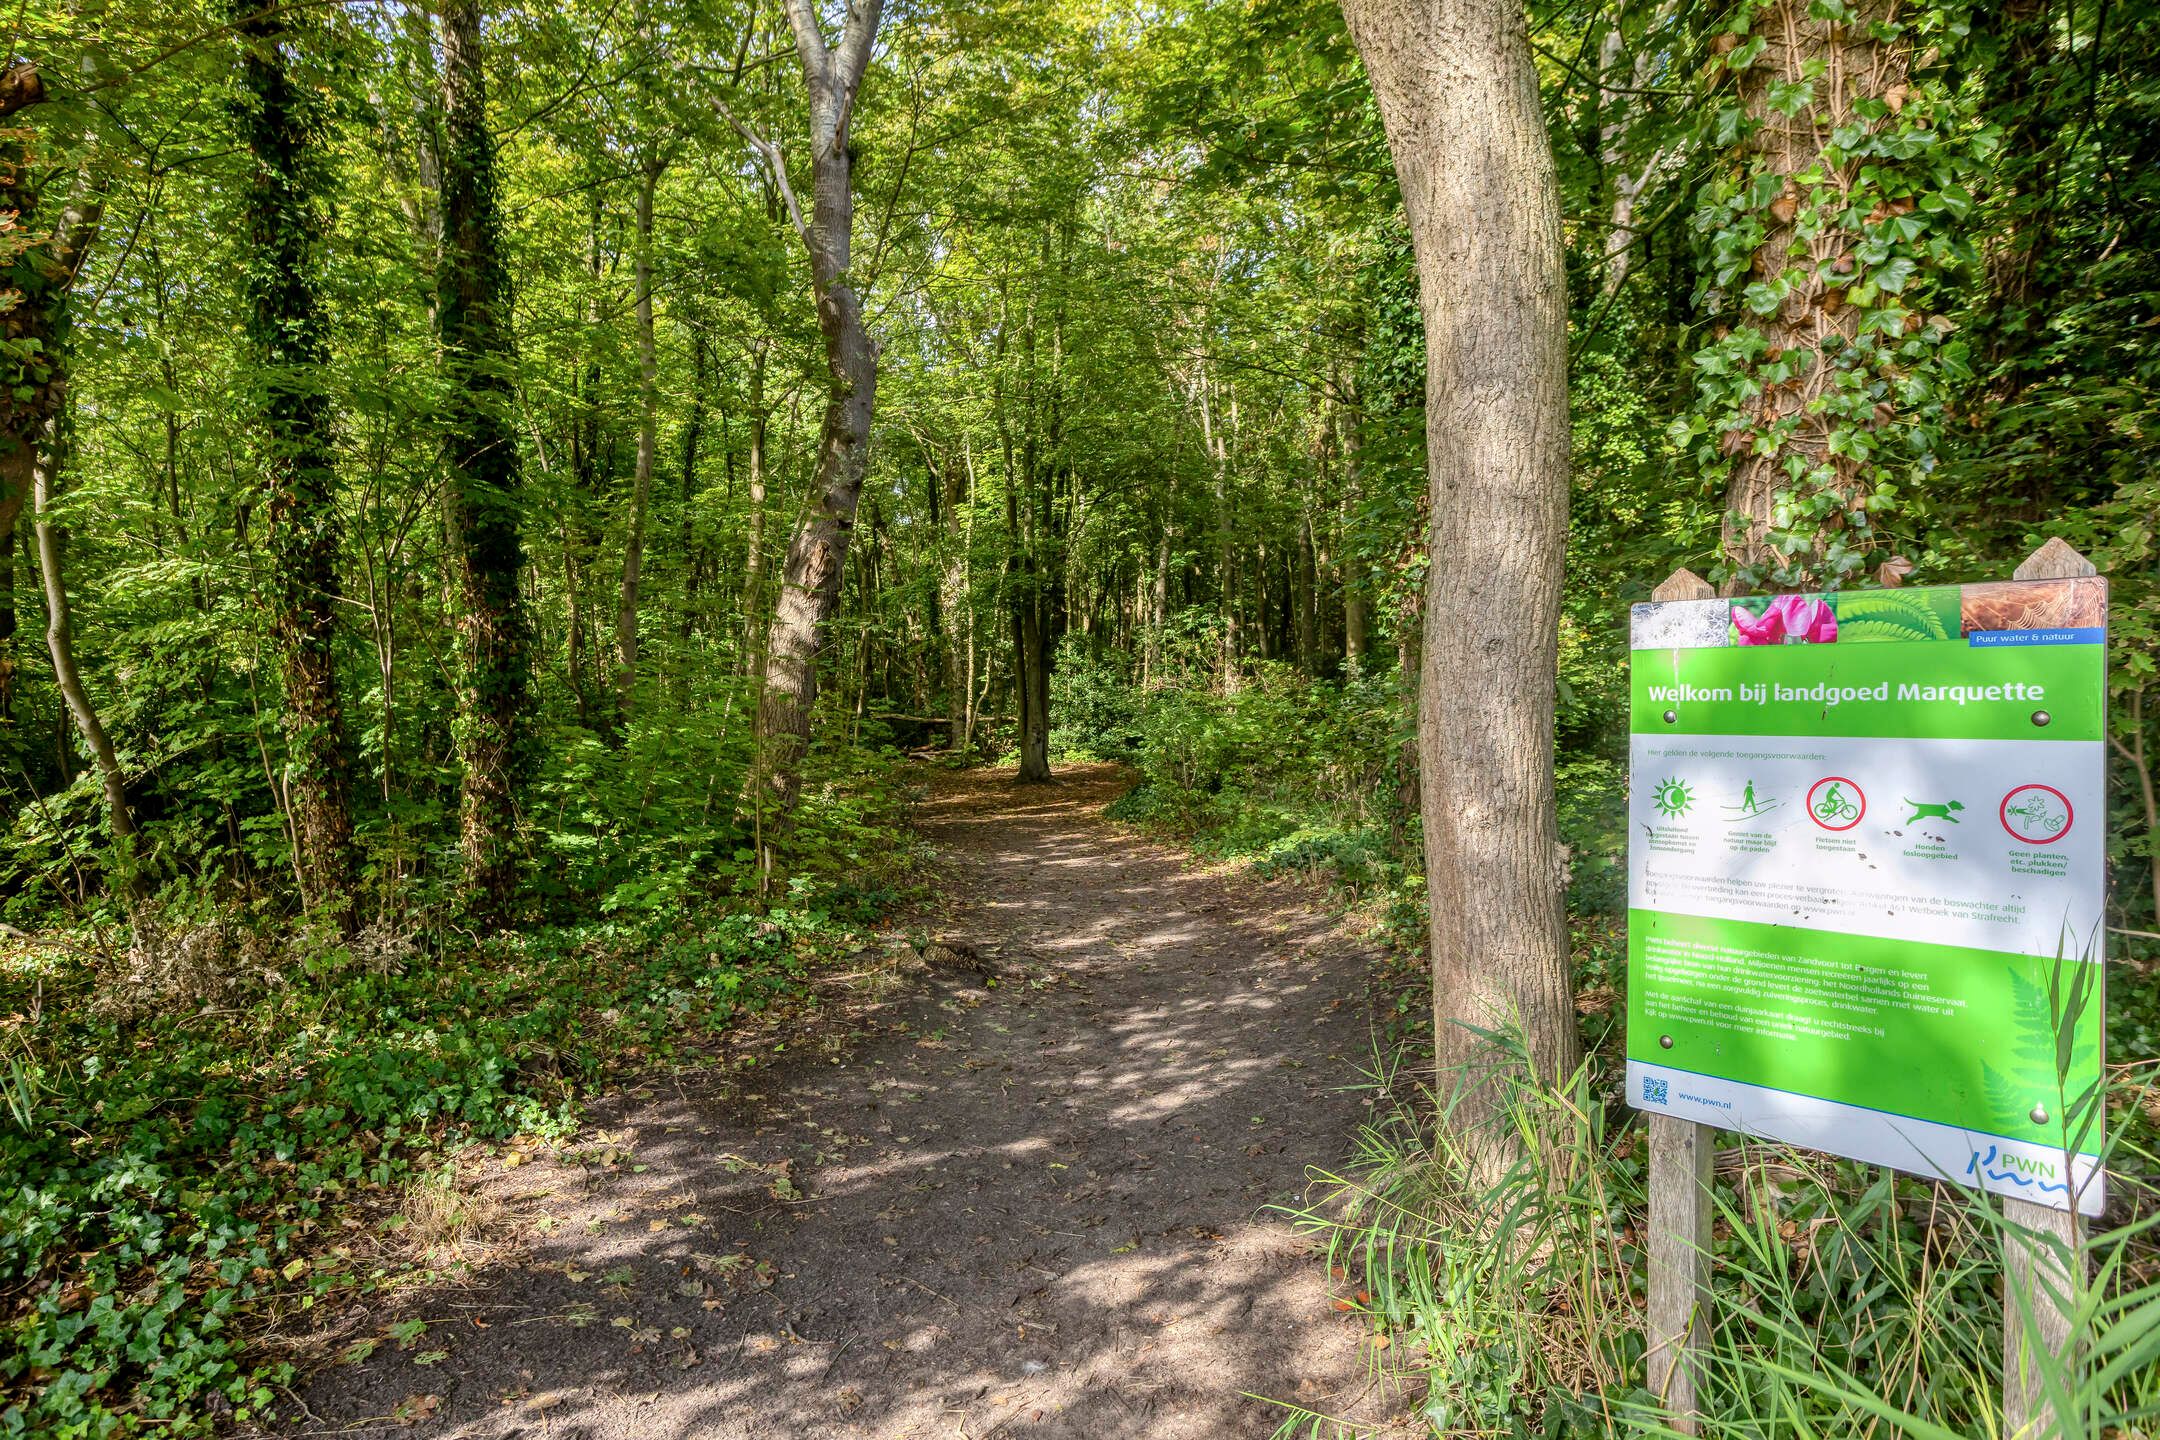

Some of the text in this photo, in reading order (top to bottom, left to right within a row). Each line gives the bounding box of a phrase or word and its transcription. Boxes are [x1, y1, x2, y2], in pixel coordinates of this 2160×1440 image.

[1976, 632, 2076, 643] Puur water & natuur
[1648, 682, 2045, 706] Welkom bij landgoed Marquette
[1648, 749, 1661, 757] Hier
[1663, 749, 1687, 759] gelden
[1700, 750, 1735, 760] volgende
[1815, 836, 1856, 846] Fietsen niet
[1816, 843, 1856, 853] toegestaan
[1915, 843, 1946, 852] Honden
[1749, 846, 1770, 854] paden
[1903, 849, 1958, 861] losloopgebied
[2008, 850, 2031, 858] Geen
[2011, 866, 2067, 876] beschadigen
[2028, 860, 2068, 869] plukken/
[1727, 877, 1753, 888] helpen
[1796, 884, 1805, 892] te
[1911, 896, 1928, 904] van
[1929, 896, 1942, 906] de
[1943, 898, 1999, 912] boswachter
[2000, 904, 2026, 915] altijd
[1735, 887, 1749, 896] kan
[1751, 890, 1766, 898] een
[1908, 904, 1950, 917] Wetboek
[1951, 910, 1969, 920] van
[1790, 903, 1802, 913] op
[1747, 959, 1786, 971] Miljoenen
[1787, 966, 1820, 976] mensen
[1863, 975, 1896, 987] jaarlijks
[1898, 980, 1910, 990] op
[1911, 982, 1930, 992] een
[1782, 954, 1796, 962] van
[1797, 956, 1839, 969] Zandvoort
[1840, 962, 1853, 971] tot
[1888, 969, 1900, 977] en
[1901, 970, 1928, 981] levert
[1707, 982, 1721, 990] een
[1722, 984, 1761, 997] zorgvuldig
[1708, 973, 1730, 982] onder
[1732, 976, 1742, 984] de
[1743, 979, 1767, 989] grond
[1767, 981, 1791, 991] levert
[1792, 985, 1803, 993] de
[1860, 996, 1890, 1007] samen
[1892, 1000, 1911, 1009] met
[1913, 1003, 1940, 1014] water
[1942, 1008, 1954, 1017] uit
[1823, 979, 1837, 988] het
[1839, 982, 1901, 998] Noordhollands
[1657, 1010, 1668, 1019] op
[1715, 1020, 1732, 1029] voor
[1733, 1023, 1754, 1033] meer
[1671, 1003, 1698, 1014] beheer
[1698, 1008, 1709, 1016] en
[1709, 1009, 1738, 1021] behoud
[1740, 1015, 1754, 1023] van
[1755, 1018, 1770, 1026] een
[1703, 1000, 1717, 1008] van
[1821, 1019, 1872, 1034] rechtstreeks
[1874, 1026, 1885, 1038] bij
[1678, 1092, 1732, 1109] www.pwn.nl
[2002, 1153, 2055, 1179] PWN
